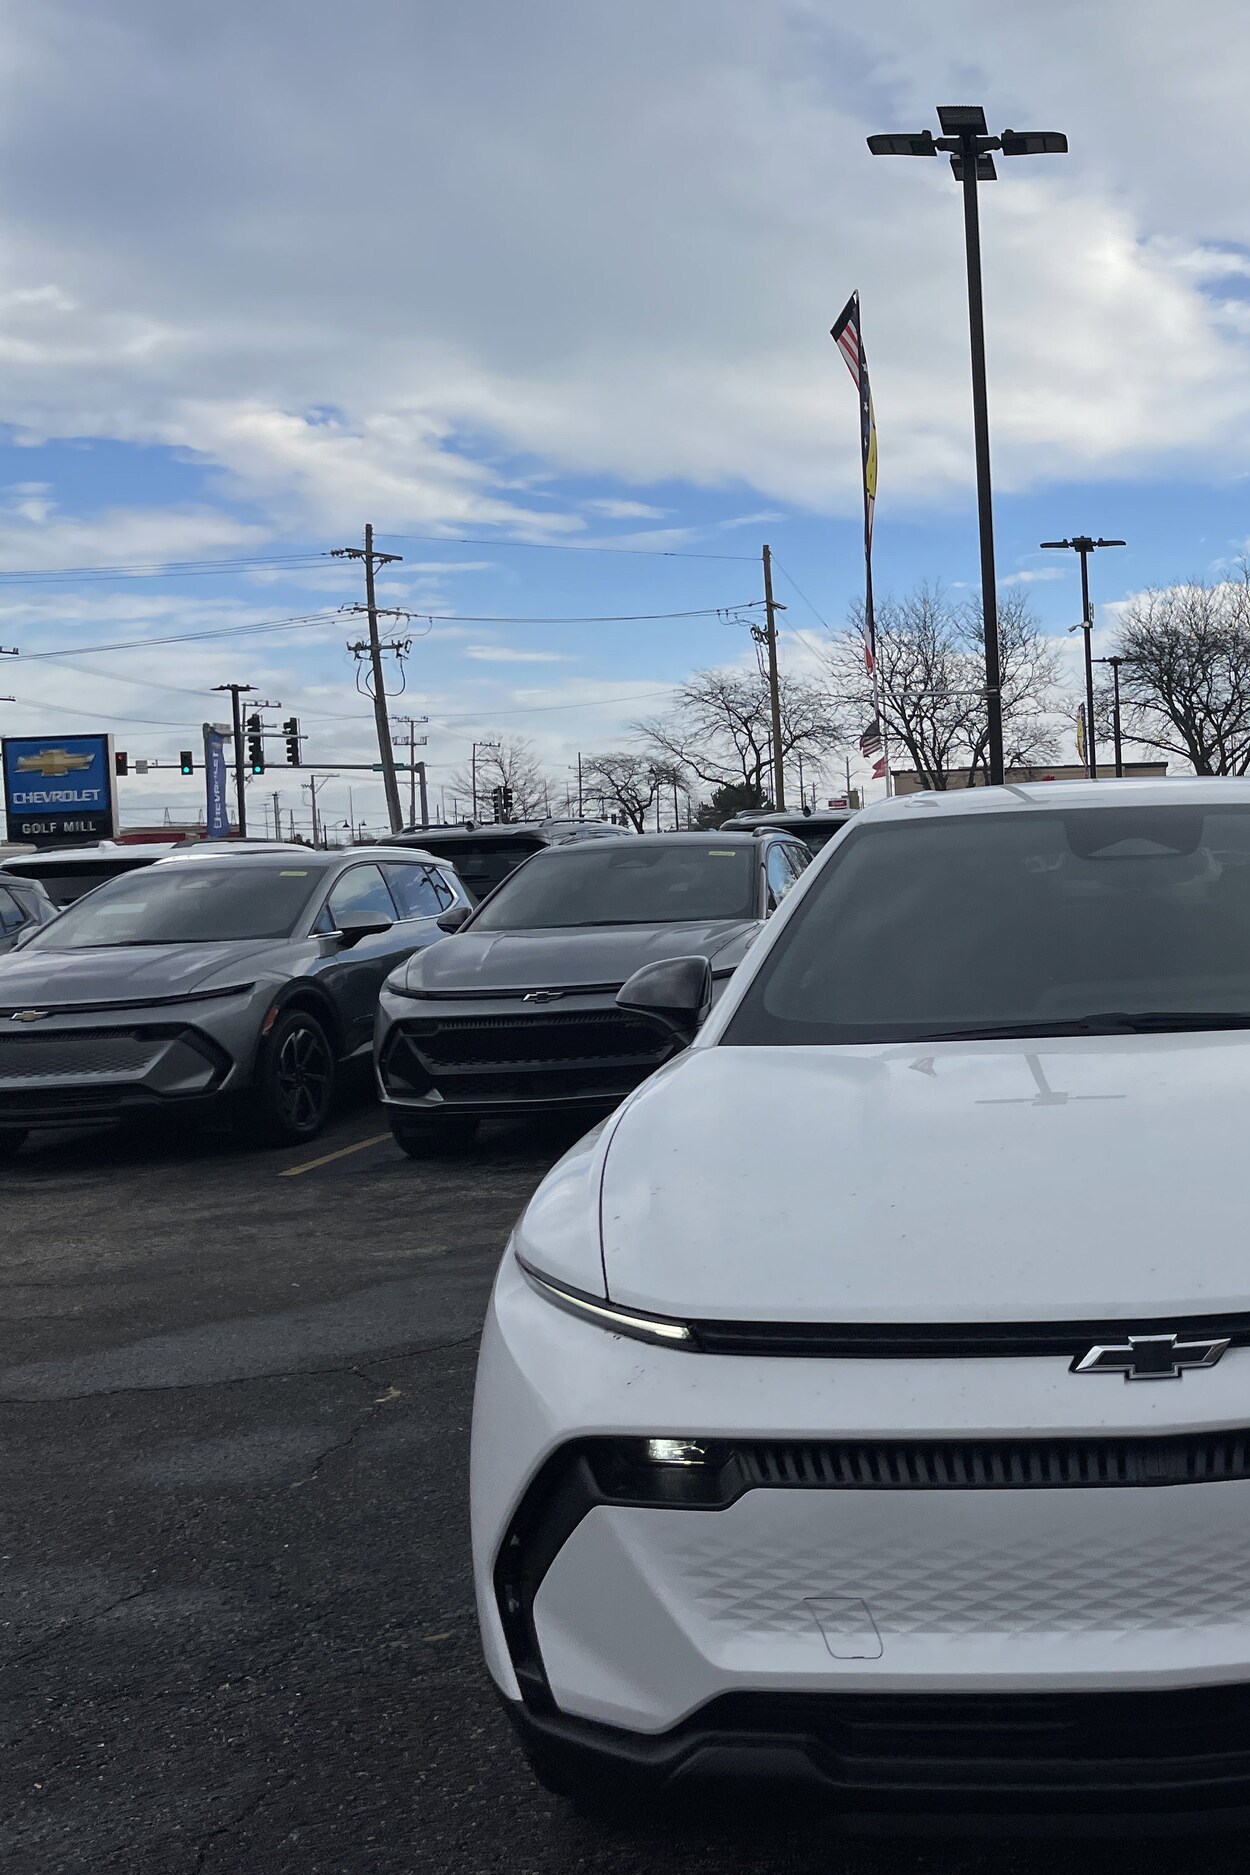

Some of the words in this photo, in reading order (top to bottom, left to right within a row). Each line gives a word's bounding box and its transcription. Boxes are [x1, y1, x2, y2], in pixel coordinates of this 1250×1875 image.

[13, 789, 101, 804] CHEVROLET
[22, 822, 57, 834] GOLF
[63, 820, 97, 832] MILL
